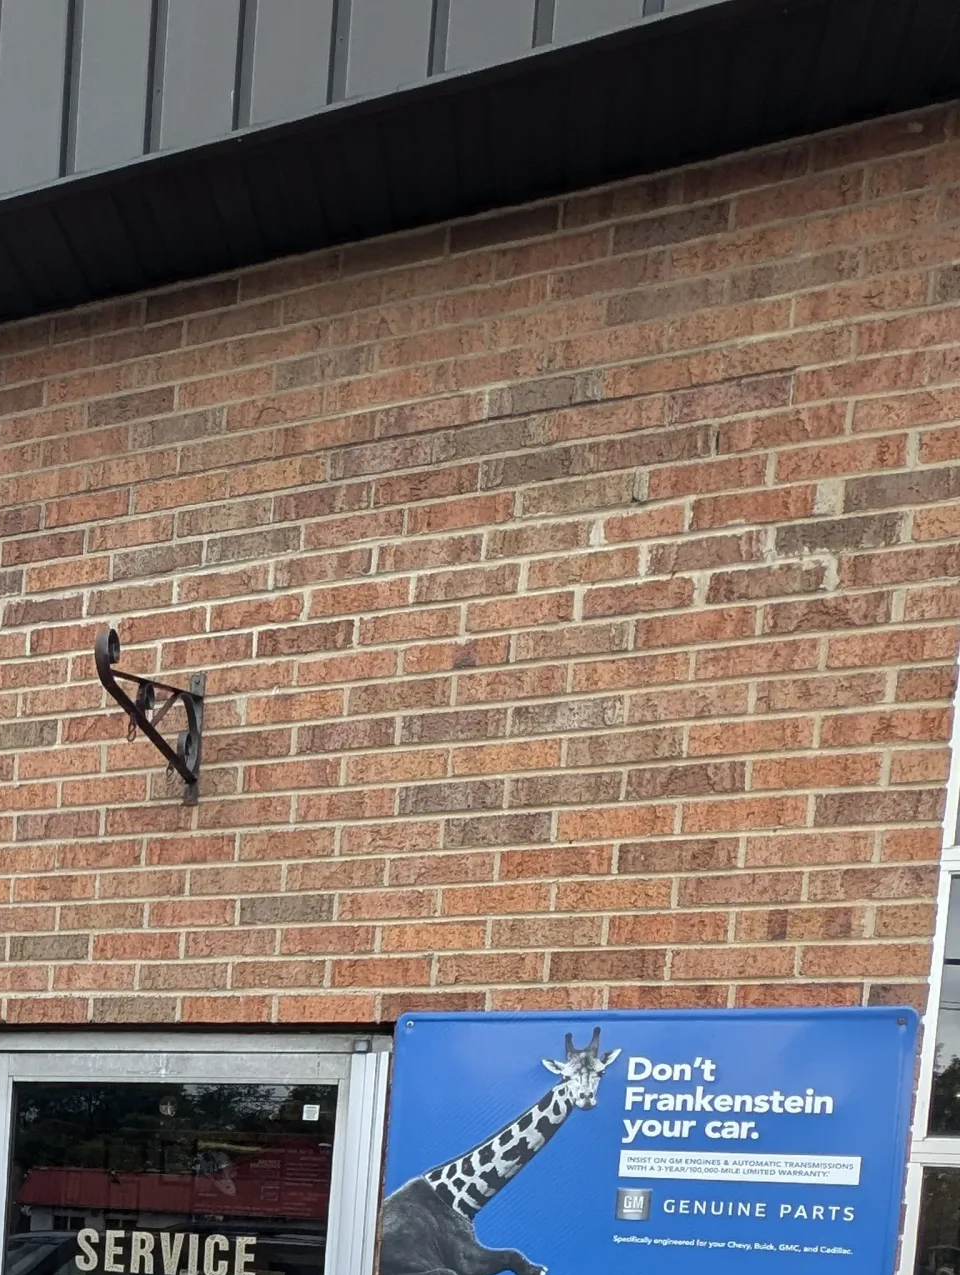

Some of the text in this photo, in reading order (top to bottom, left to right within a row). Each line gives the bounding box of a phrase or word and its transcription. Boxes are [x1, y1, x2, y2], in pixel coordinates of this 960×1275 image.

[624, 1086, 834, 1115] Frankenstein
[621, 1117, 759, 1144] your car.
[627, 1156, 652, 1164] INSIST
[669, 1157, 683, 1165] GM
[685, 1158, 721, 1166] ENGINES
[732, 1159, 781, 1168] AUTOMATIC
[784, 1161, 854, 1170] TRANSMISSIONS
[743, 1168, 776, 1176] LIMITED
[623, 1195, 644, 1209] GM
[663, 1199, 855, 1221] GENUINE PARTS
[613, 1234, 652, 1245] Specifically
[654, 1238, 695, 1247] engineered
[696, 1239, 707, 1247] for
[708, 1241, 726, 1249] your
[727, 1241, 752, 1251] Chevy,
[779, 1244, 801, 1253] GMC,
[803, 1245, 818, 1253] and
